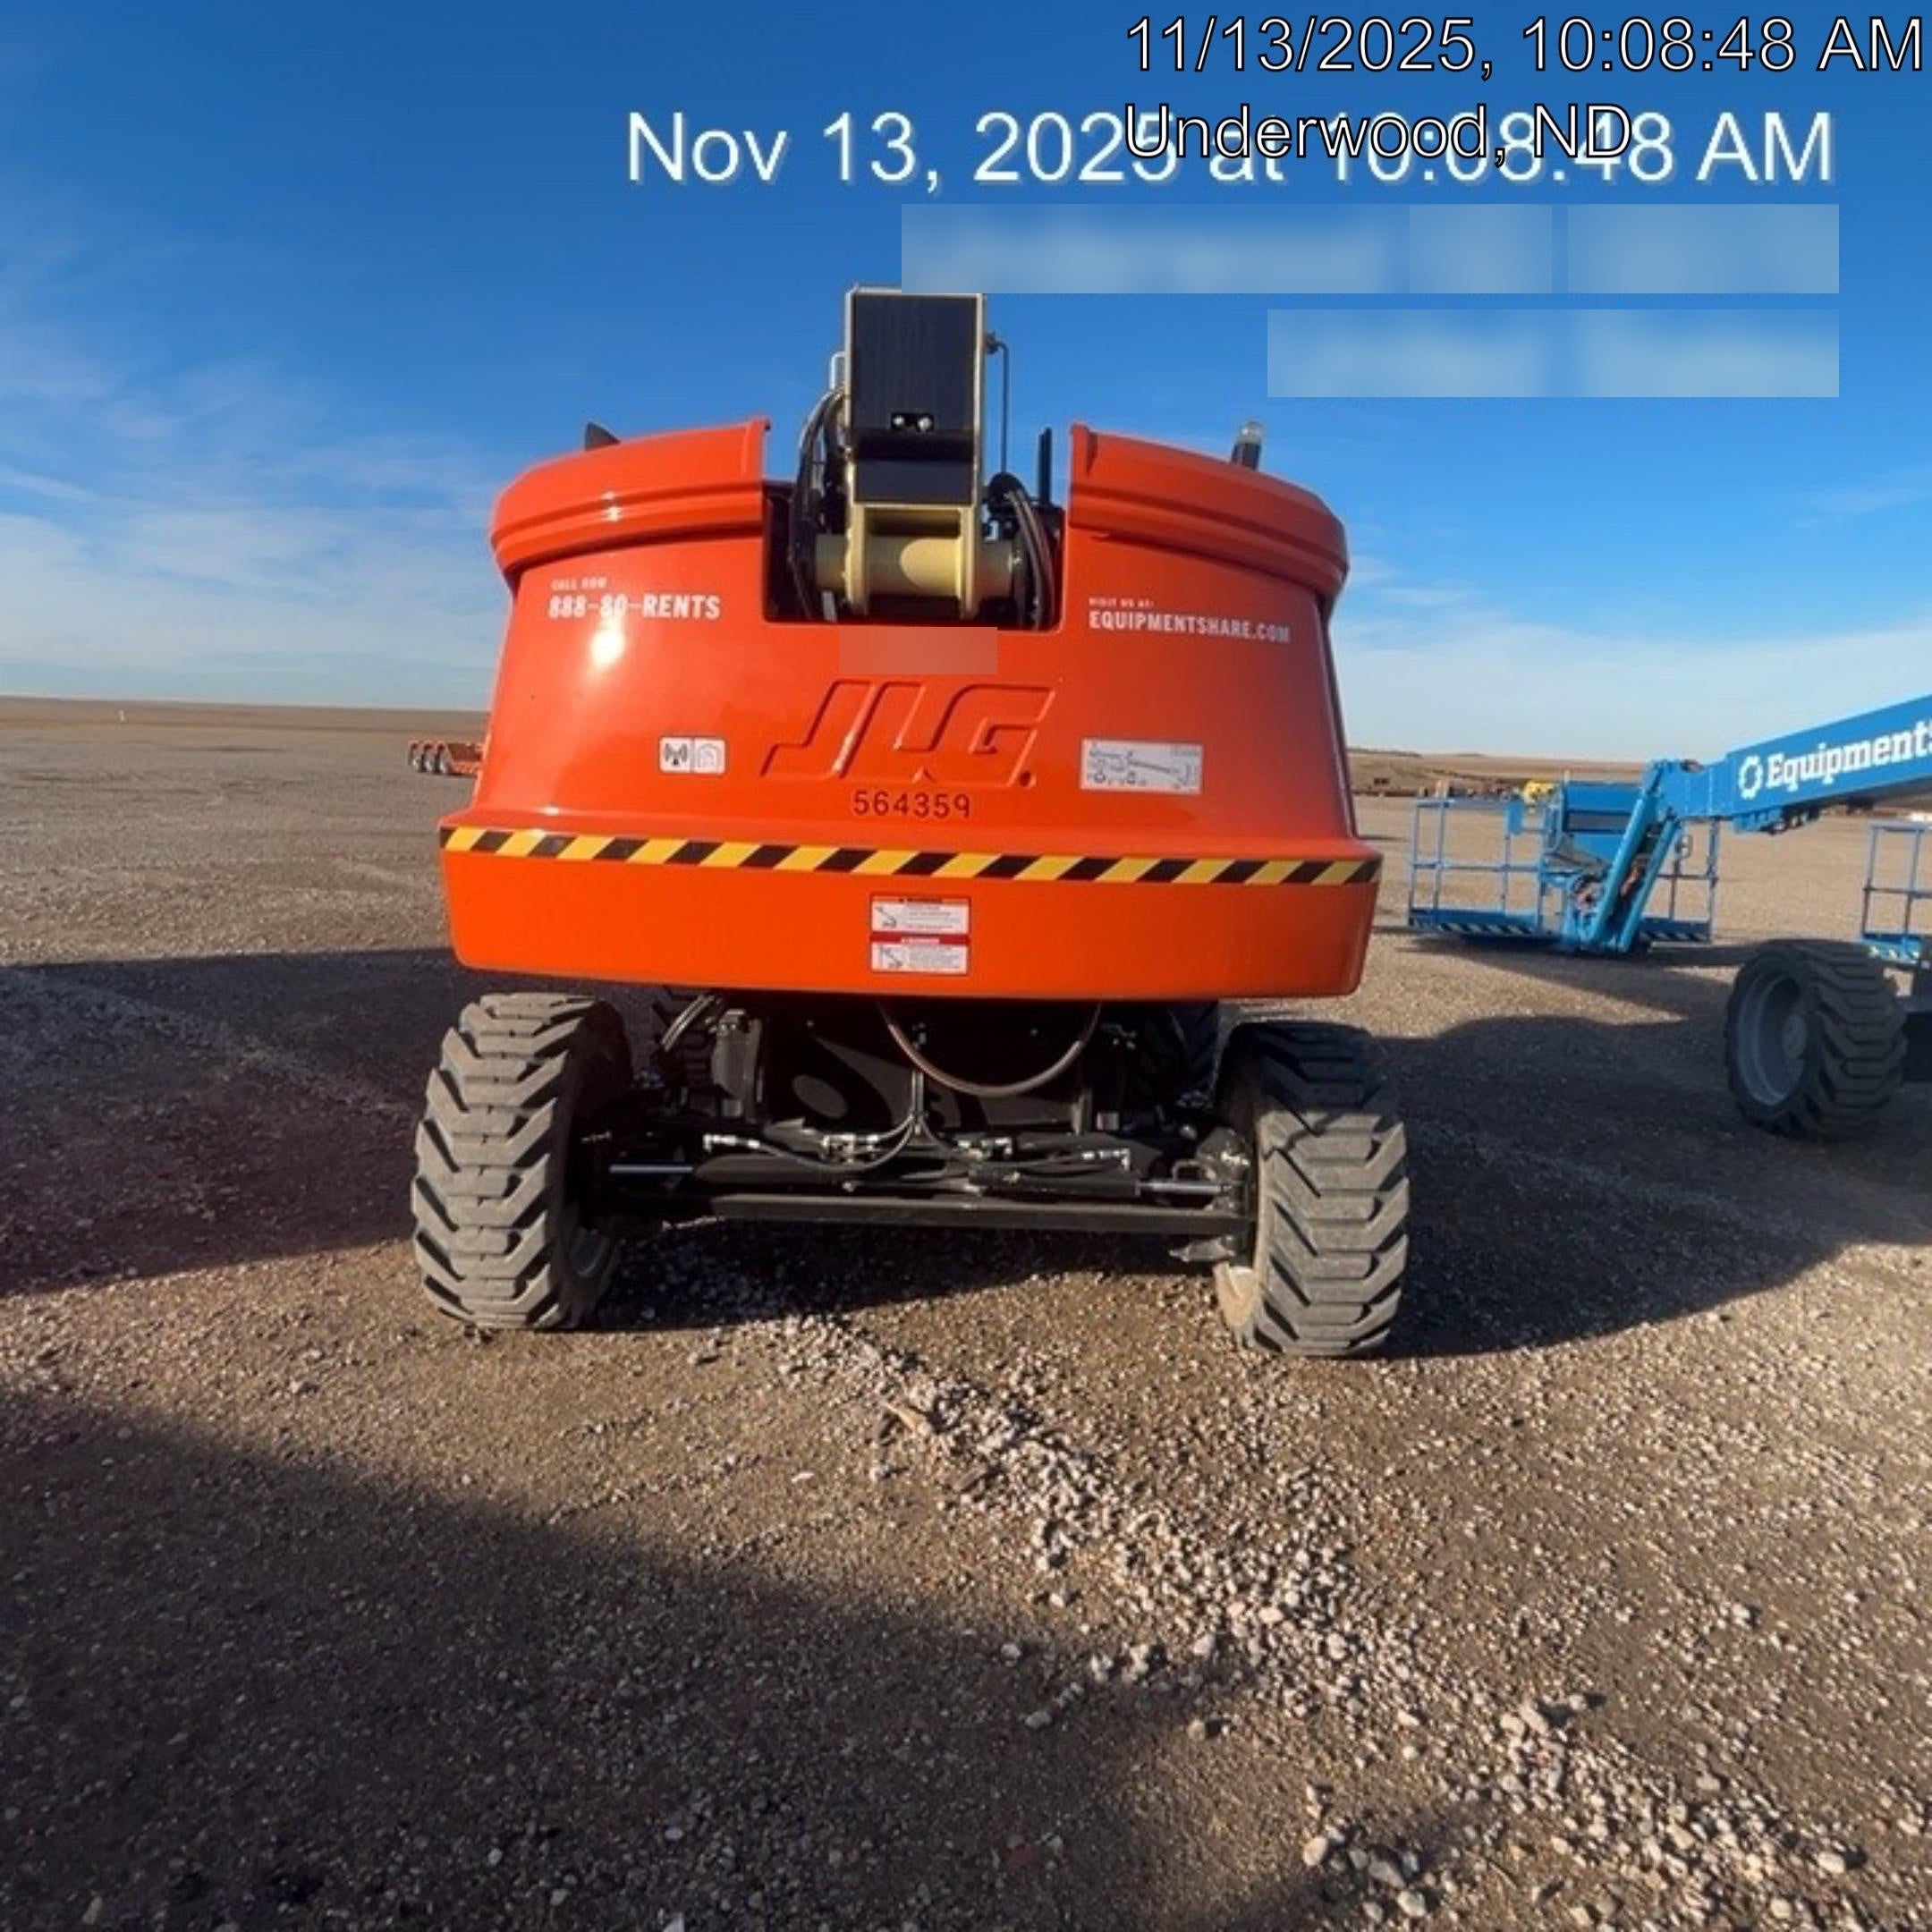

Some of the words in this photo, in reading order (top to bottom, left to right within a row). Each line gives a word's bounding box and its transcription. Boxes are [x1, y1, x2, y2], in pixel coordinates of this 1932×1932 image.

[1089, 610, 1290, 643] EQUIPMENTSHARE.COM
[1766, 718, 1932, 792] Equipment
[852, 790, 970, 819] 564359
